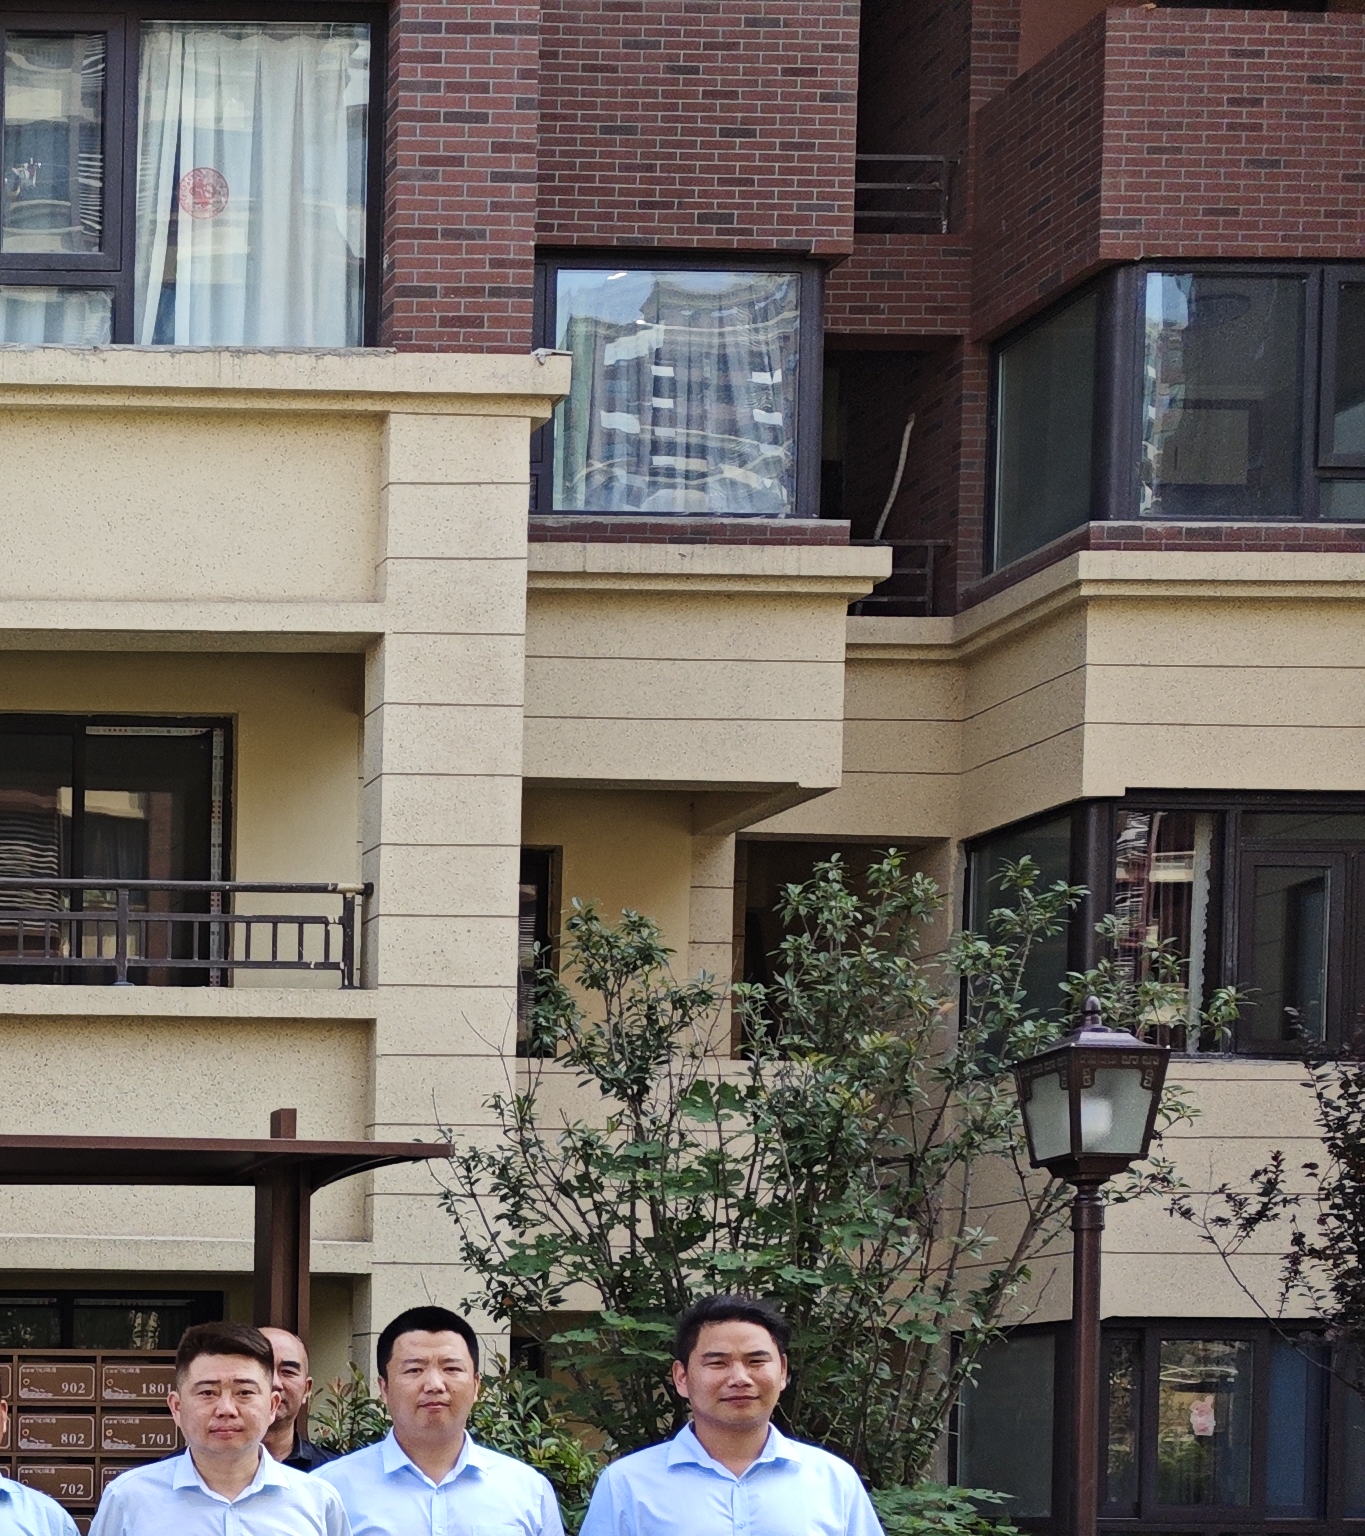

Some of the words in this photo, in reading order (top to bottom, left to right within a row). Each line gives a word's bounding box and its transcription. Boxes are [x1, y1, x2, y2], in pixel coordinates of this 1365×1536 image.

[61, 1382, 86, 1394] 902
[141, 1383, 172, 1394] 1801
[60, 1433, 85, 1445] 802
[141, 1433, 172, 1445] 1701
[59, 1483, 84, 1495] 702
